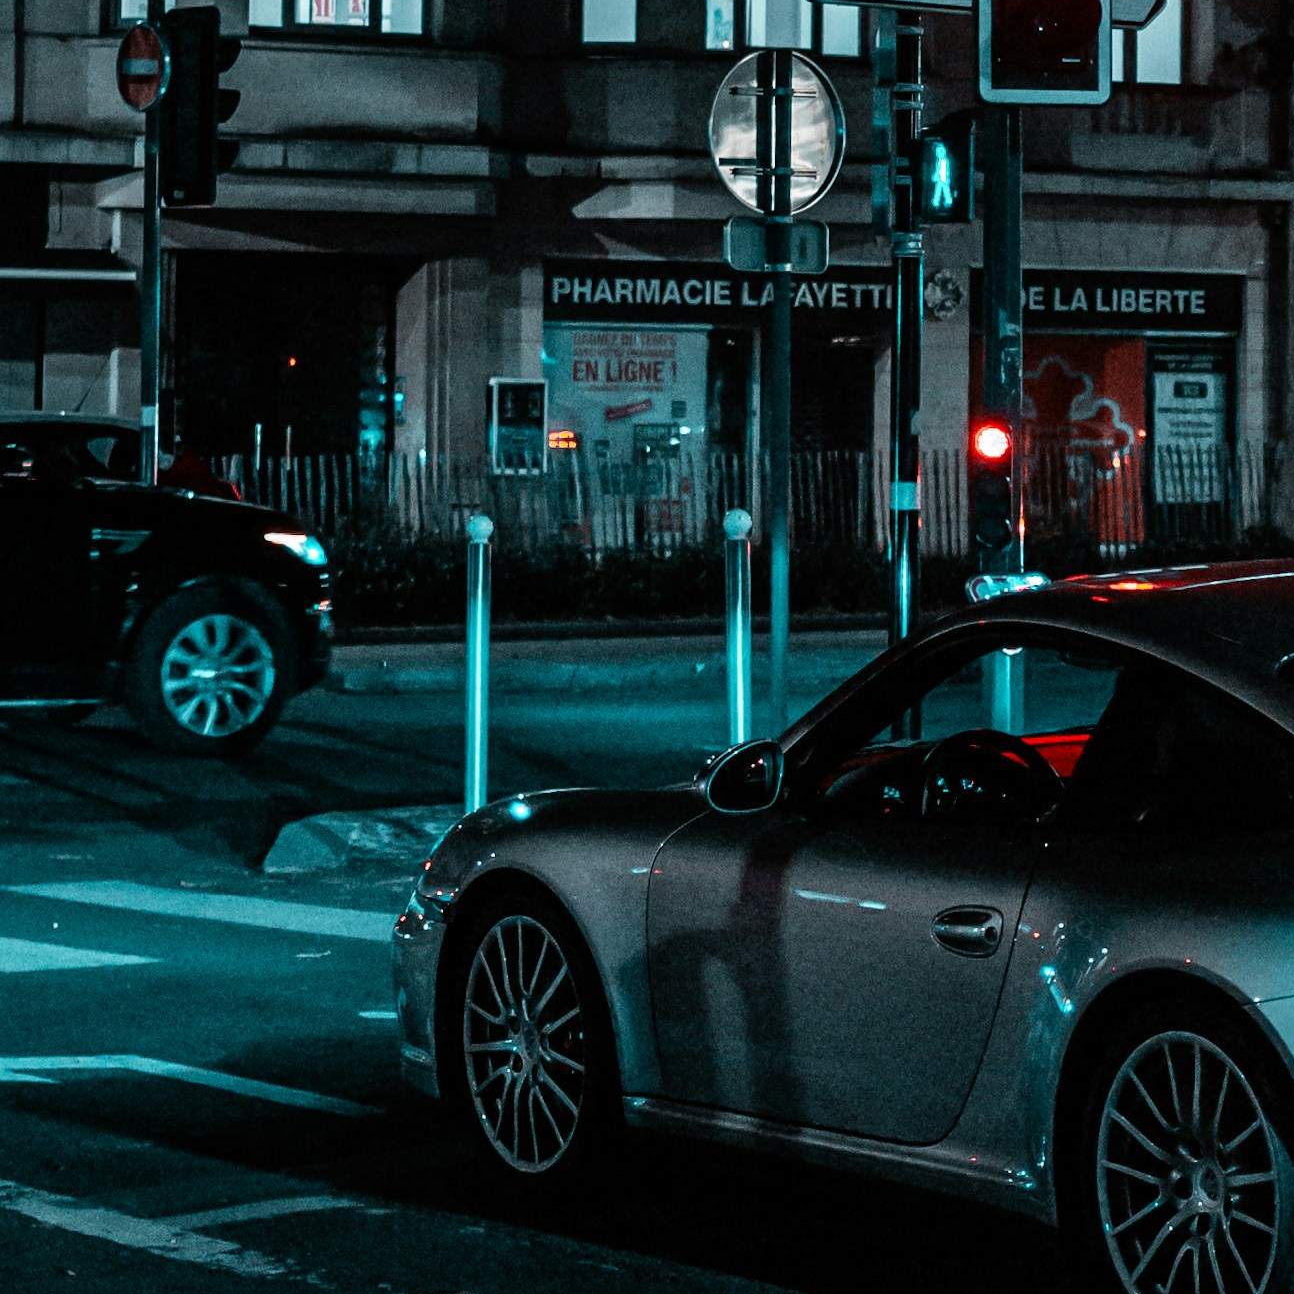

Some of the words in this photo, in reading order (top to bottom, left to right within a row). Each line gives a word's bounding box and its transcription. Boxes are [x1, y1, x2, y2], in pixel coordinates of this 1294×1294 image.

[551, 276, 732, 305] PHARMACIE
[1054, 286, 1089, 312] LA
[1096, 287, 1206, 314] LIBERTE
[572, 360, 599, 382] EN
[605, 359, 665, 383] LIGNE
